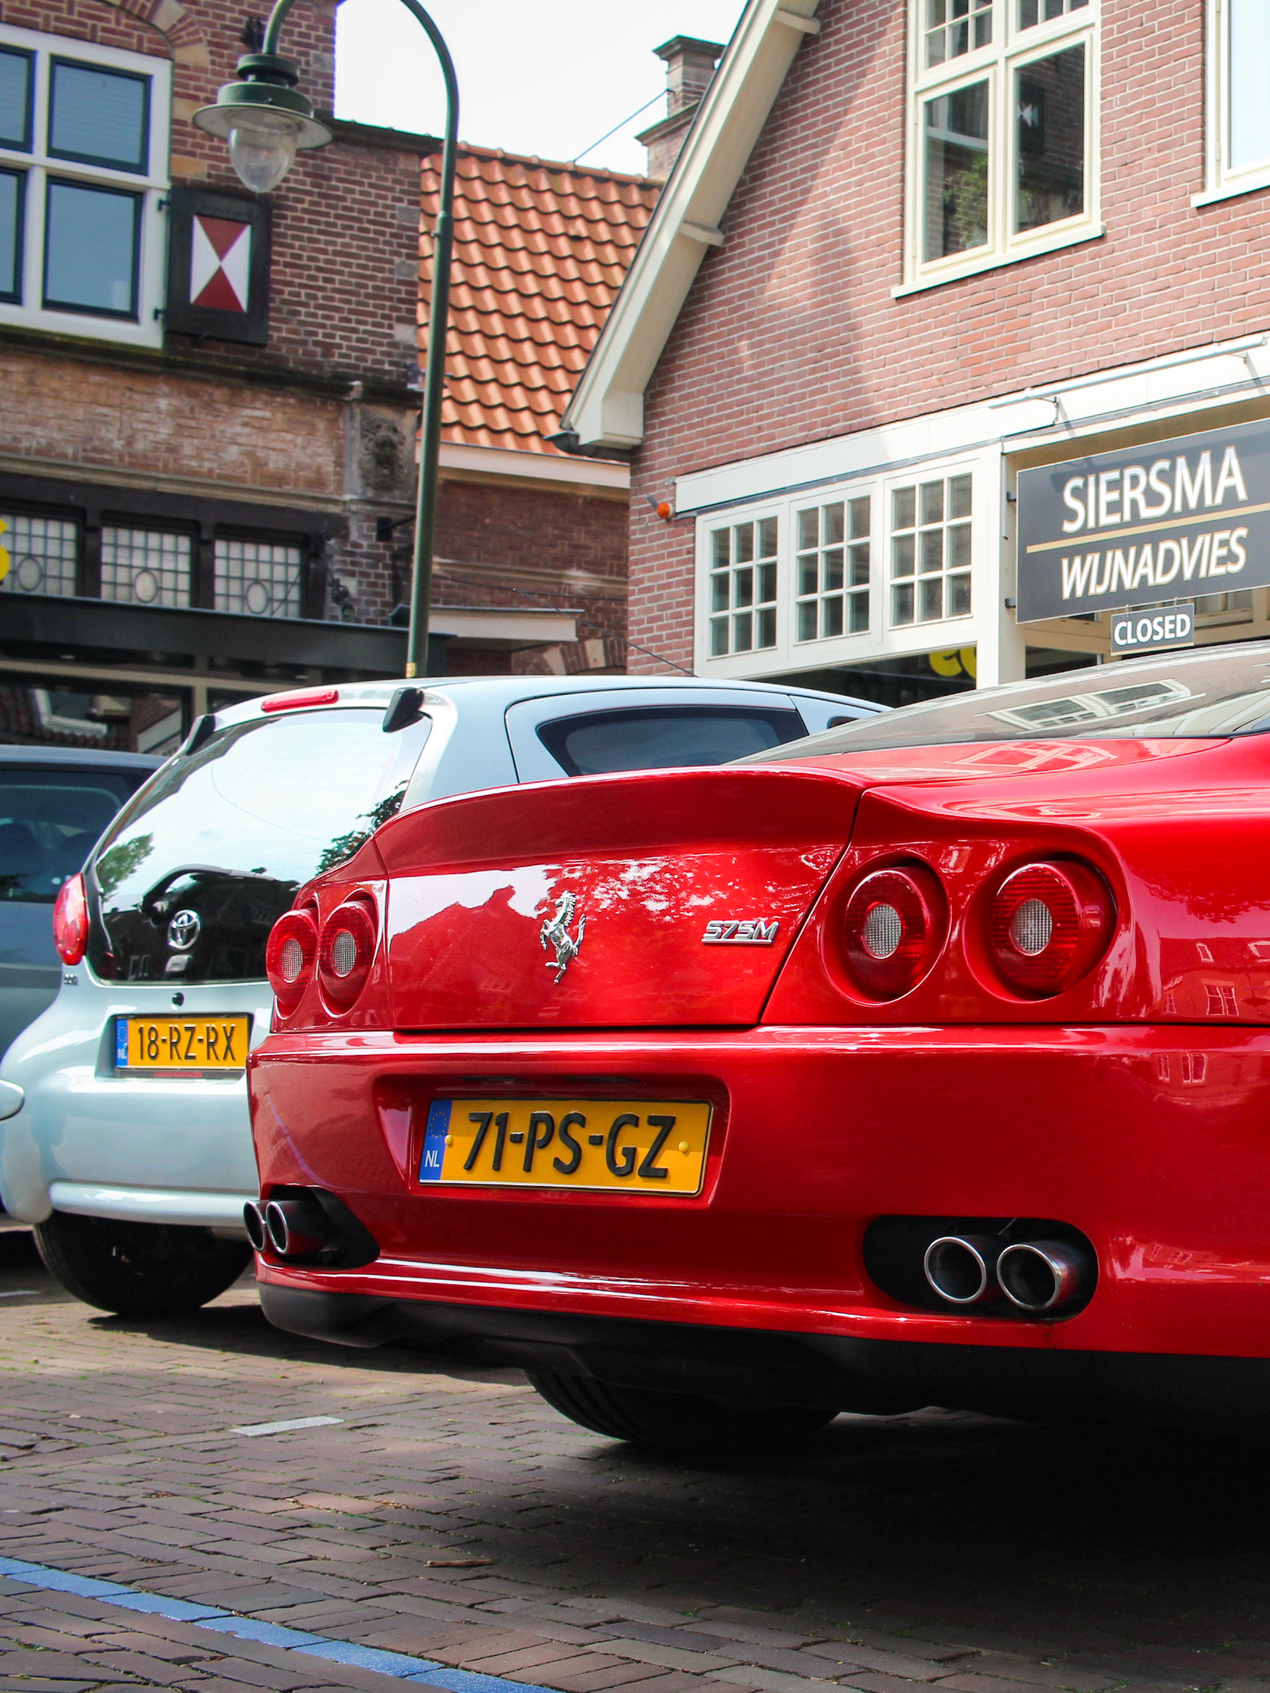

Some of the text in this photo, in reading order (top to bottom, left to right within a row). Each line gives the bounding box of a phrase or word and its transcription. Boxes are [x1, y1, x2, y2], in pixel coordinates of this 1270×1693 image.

[1061, 445, 1248, 533] SIERSMA
[1061, 527, 1249, 600] WIJNADVIES
[1114, 614, 1191, 646] CLOSED
[702, 920, 779, 944] 575M
[117, 1048, 127, 1059] NL
[138, 1023, 236, 1061] 18-RZ-RX
[424, 1149, 440, 1168] NL
[463, 1110, 676, 1178] 71-PS-GZ
